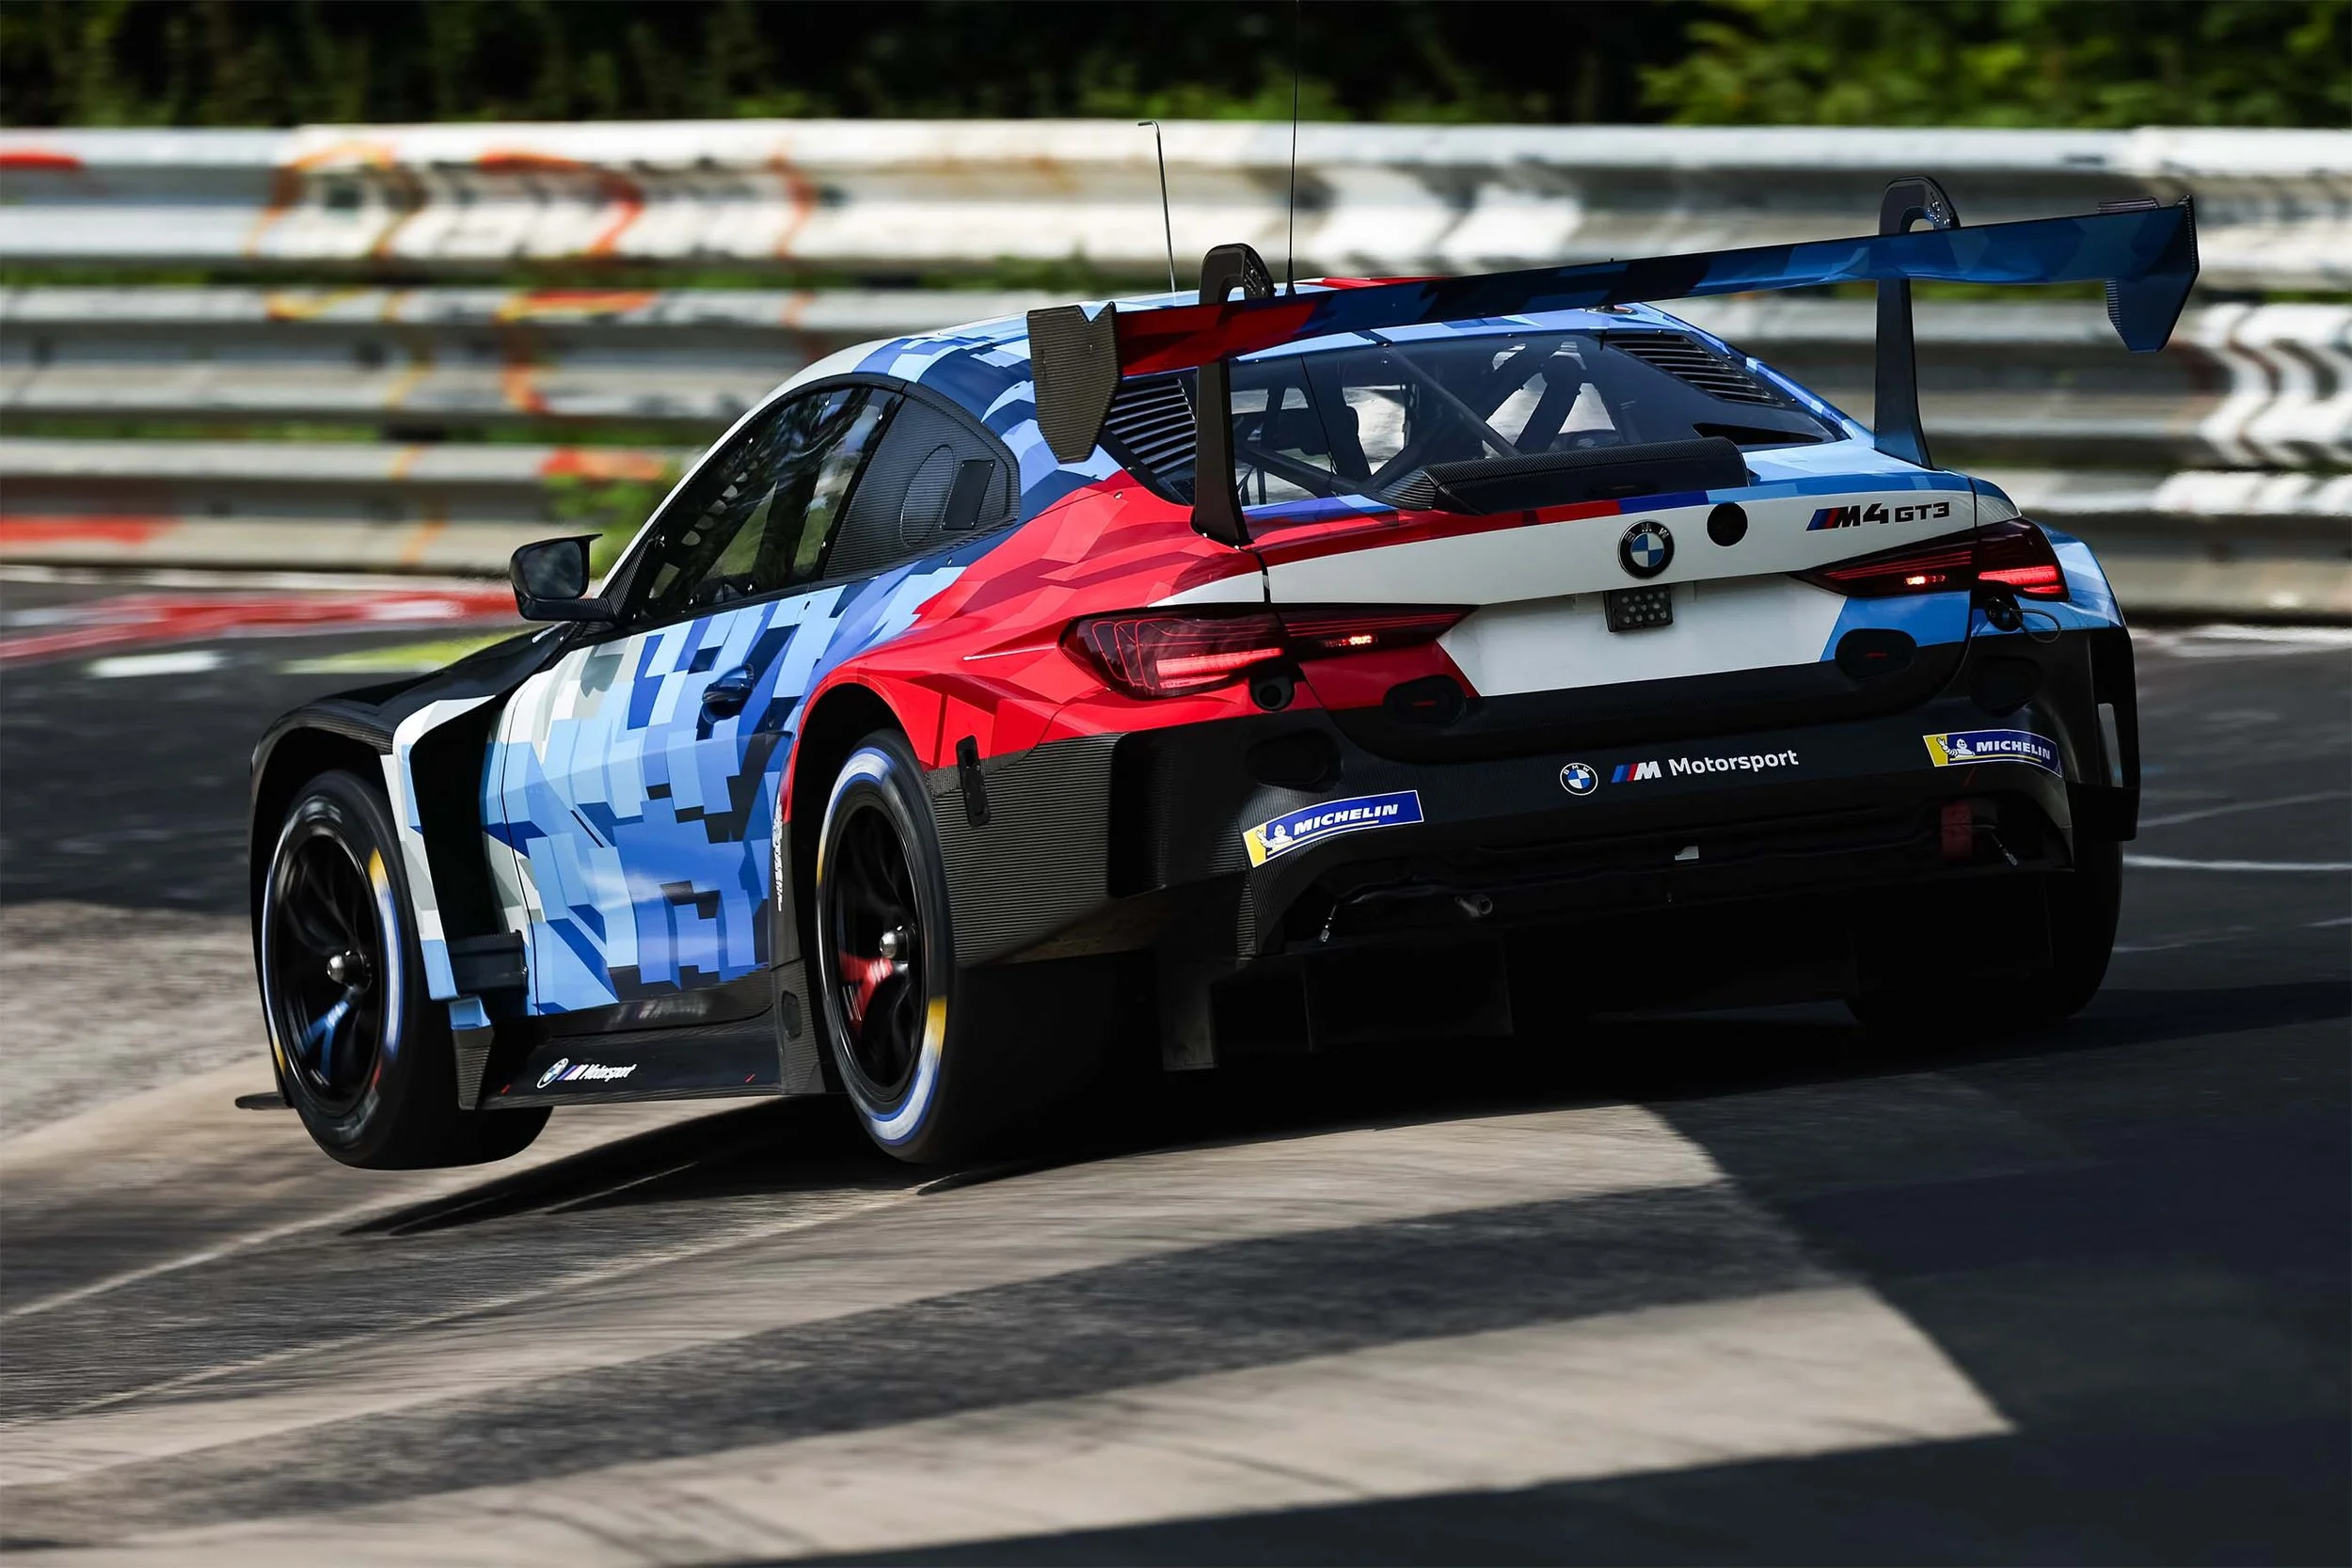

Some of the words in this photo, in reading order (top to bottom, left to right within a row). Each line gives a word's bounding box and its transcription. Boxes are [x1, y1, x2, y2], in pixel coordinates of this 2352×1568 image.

[1827, 502, 1889, 530] M4
[1894, 501, 1950, 523] GT3
[1624, 523, 1670, 543] BMW
[1976, 739, 2051, 760] MICHELIN
[1668, 750, 1799, 777] Motorsport
[1294, 803, 1399, 836] MICHELIN
